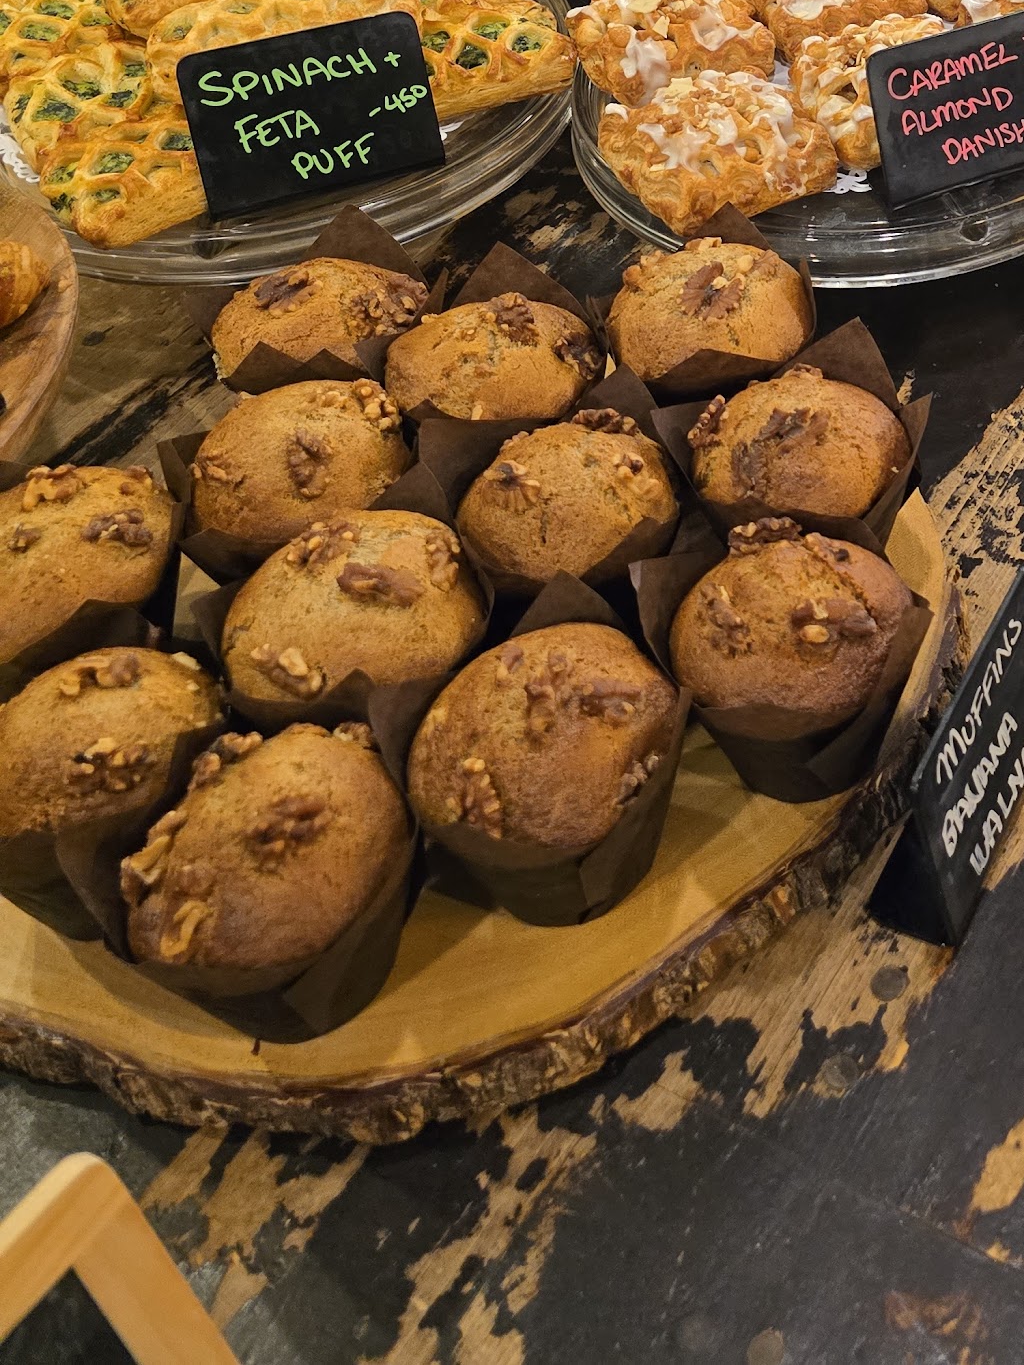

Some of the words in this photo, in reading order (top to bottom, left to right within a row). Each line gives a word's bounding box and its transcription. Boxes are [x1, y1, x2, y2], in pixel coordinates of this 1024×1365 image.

[198, 47, 377, 107] SPINACH
[383, 51, 401, 68] +
[887, 41, 1019, 100] CARAMEL
[233, 109, 320, 153] FETA
[901, 86, 1014, 136] ALMOND
[291, 132, 375, 180] PUFF
[935, 618, 1023, 785] MUFFINS
[941, 711, 1019, 859] BANANA
